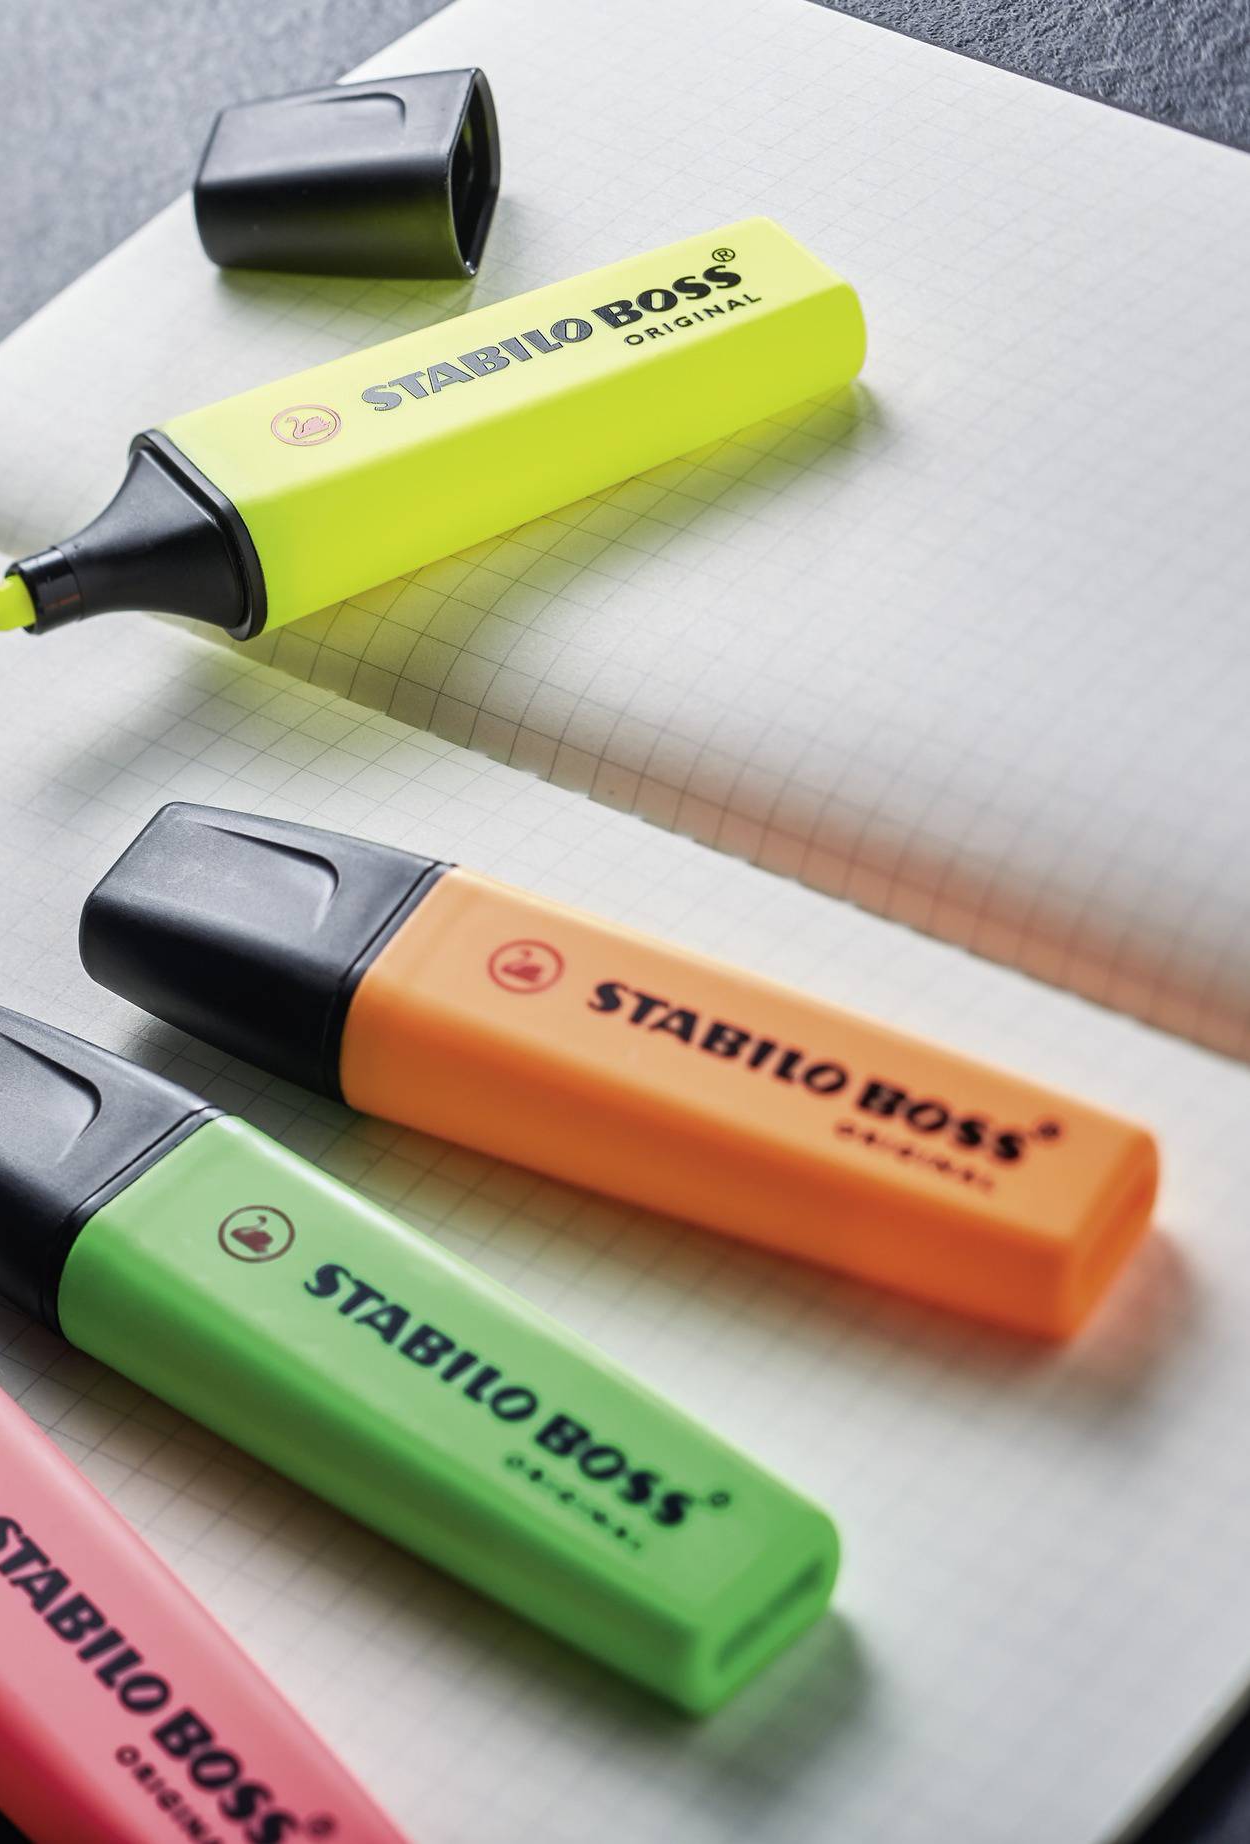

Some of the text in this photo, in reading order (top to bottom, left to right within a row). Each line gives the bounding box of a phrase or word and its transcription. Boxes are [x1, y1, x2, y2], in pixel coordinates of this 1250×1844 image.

[361, 318, 593, 412] STABILO
[623, 293, 762, 347] ORIGINAL
[587, 980, 848, 1096] STABILO
[303, 1263, 539, 1423] STABILO
